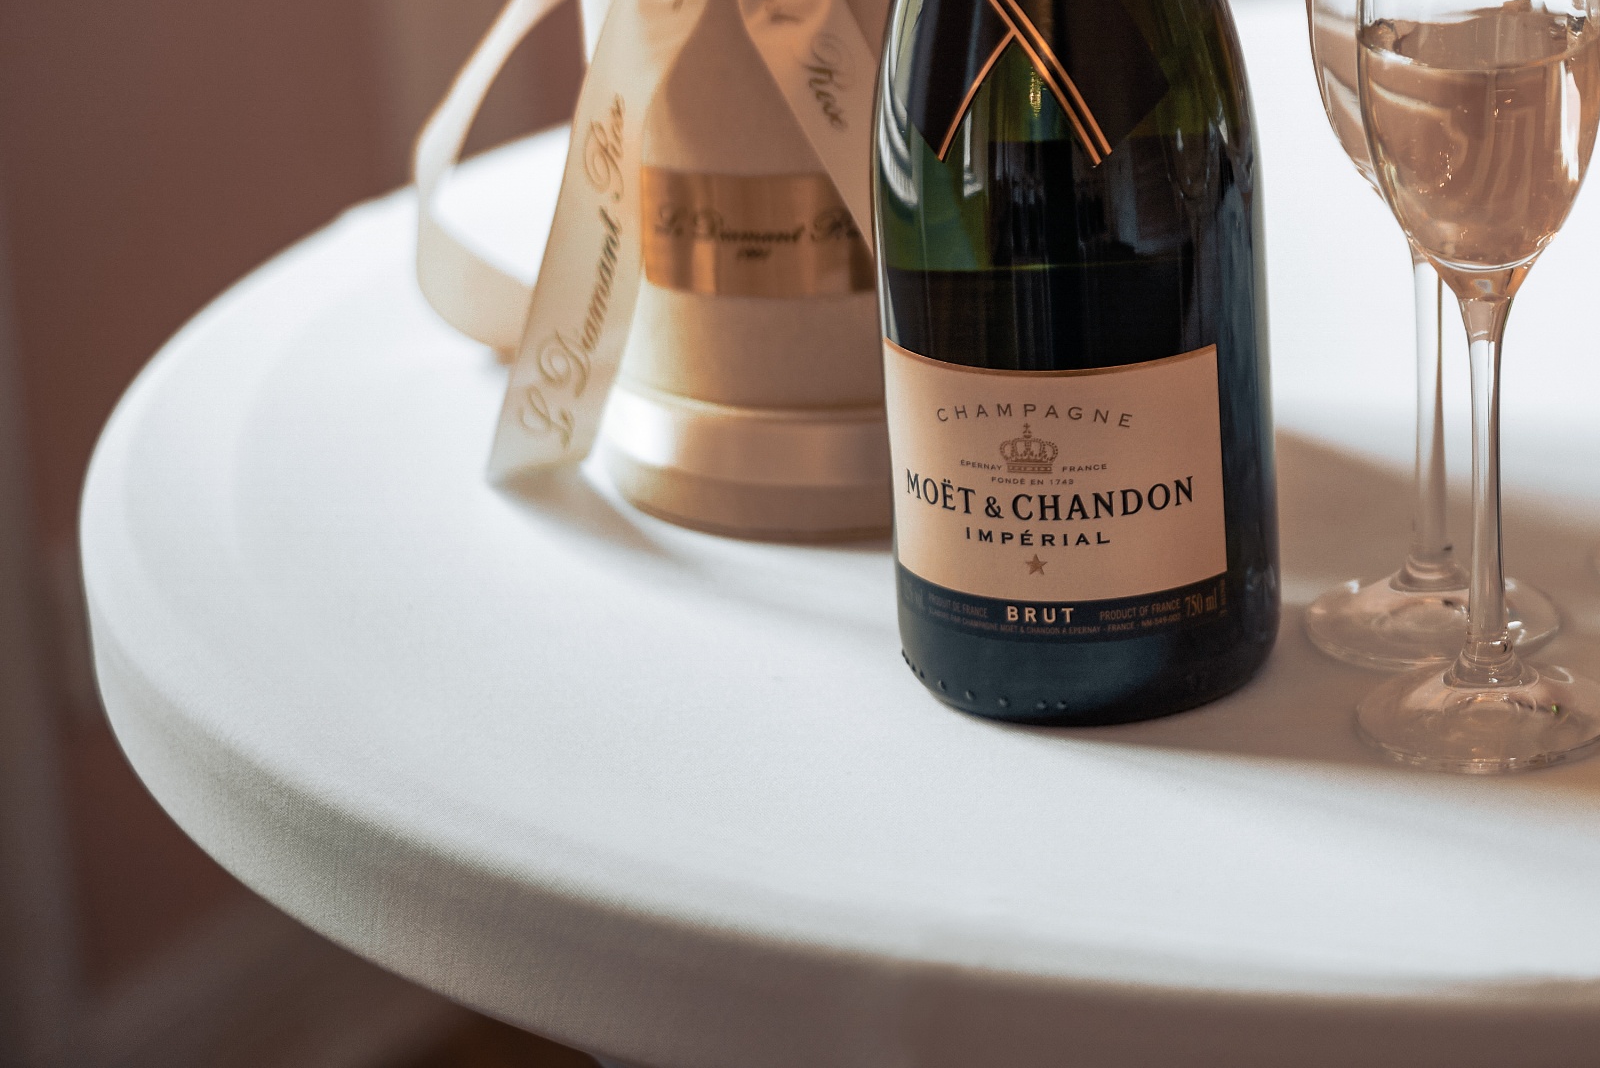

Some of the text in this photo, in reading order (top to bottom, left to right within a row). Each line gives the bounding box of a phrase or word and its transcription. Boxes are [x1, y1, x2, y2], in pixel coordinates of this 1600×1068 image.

[936, 403, 1134, 429] CHAMPAGNE
[1062, 463, 1108, 473] FRANCE
[991, 475, 1026, 486] FONDÉ
[1030, 478, 1044, 486] EN
[906, 468, 1194, 522] MOËT & CHANDON
[965, 526, 1111, 547] IMPÉRIAL
[1099, 598, 1181, 622] PRODUCT OF FRANCE
[1184, 592, 1203, 619] 750
[1205, 587, 1217, 612] ml
[1006, 605, 1075, 624] BRUT
